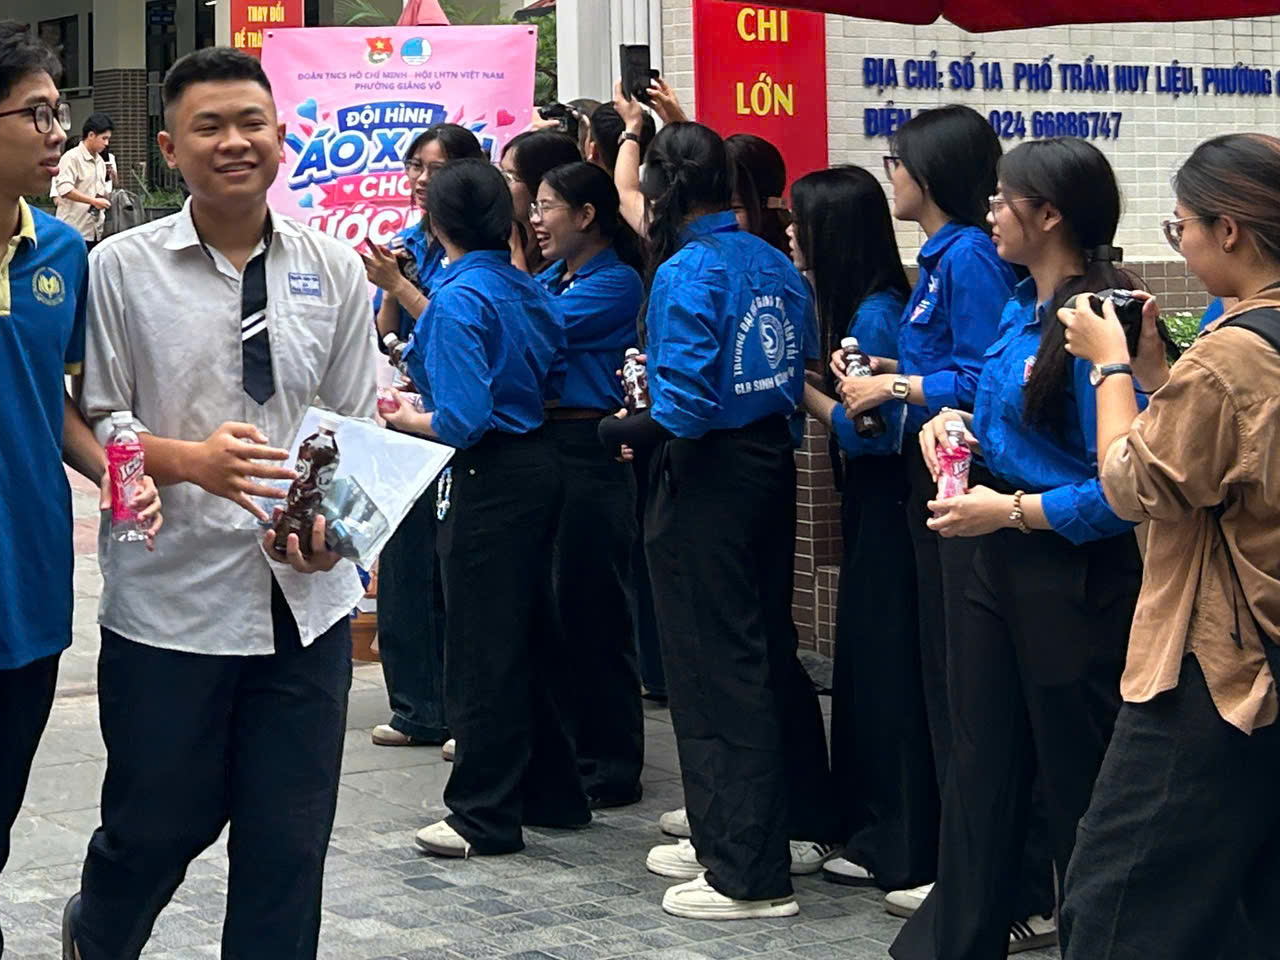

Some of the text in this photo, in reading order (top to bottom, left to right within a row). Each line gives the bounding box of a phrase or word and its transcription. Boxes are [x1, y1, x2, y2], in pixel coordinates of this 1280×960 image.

[247, 1, 285, 22] THAY ĐỔI
[736, 6, 789, 42] CHI
[325, 71, 347, 80] TNCS
[382, 70, 408, 79] MINH
[482, 71, 505, 81] NAM
[863, 57, 899, 96] ĐỊA
[904, 50, 945, 89] CHỈ:
[949, 51, 977, 91] SỐ
[980, 61, 1004, 91] 1A
[1013, 53, 1055, 92] PHỐ
[1114, 64, 1150, 94] HUY
[1154, 59, 1199, 100] LIỆU,
[736, 72, 794, 117] LỚN
[346, 103, 433, 130] ĐỘI HÌNH
[988, 110, 1027, 139] 024
[1031, 110, 1123, 141] 66886747
[292, 124, 366, 180] ÁO
